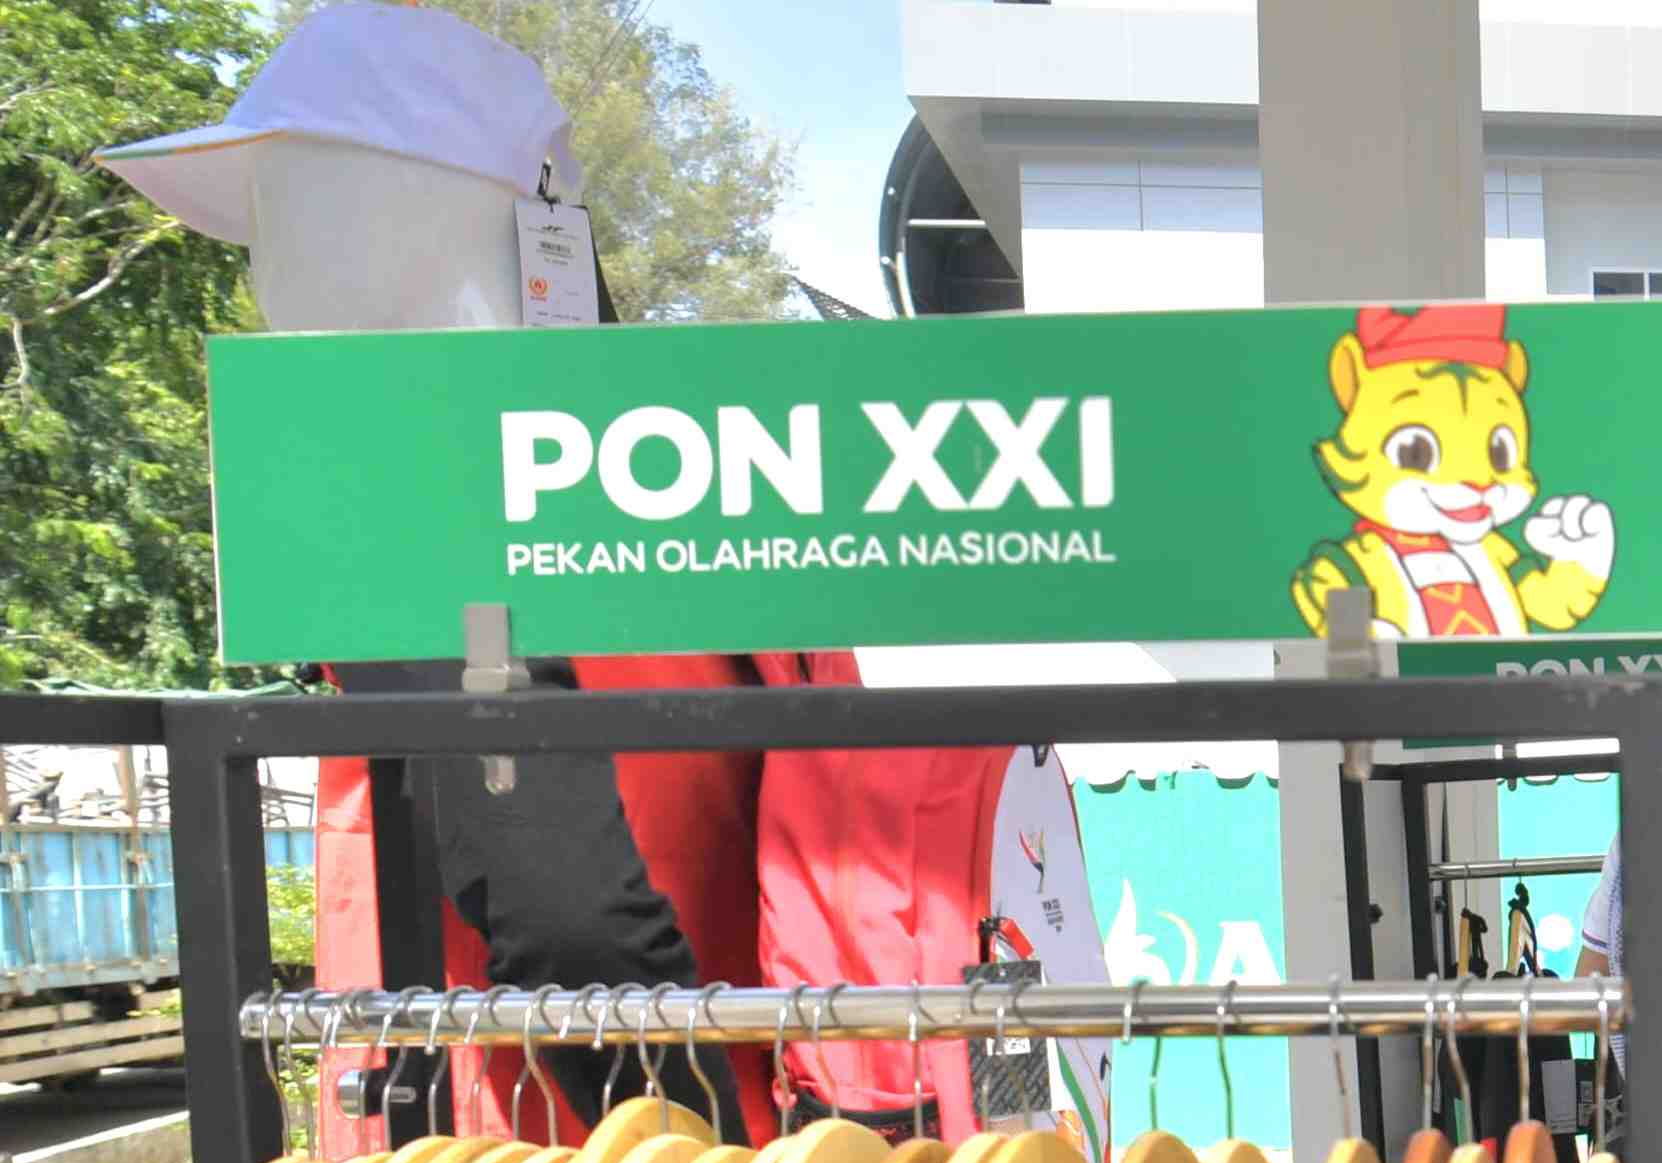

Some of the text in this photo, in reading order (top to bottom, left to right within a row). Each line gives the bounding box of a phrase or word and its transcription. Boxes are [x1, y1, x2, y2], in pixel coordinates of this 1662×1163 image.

[501, 396, 1114, 523] PON XXI
[506, 531, 1115, 576] PEKAN OLAHRAGA NASIONAL
